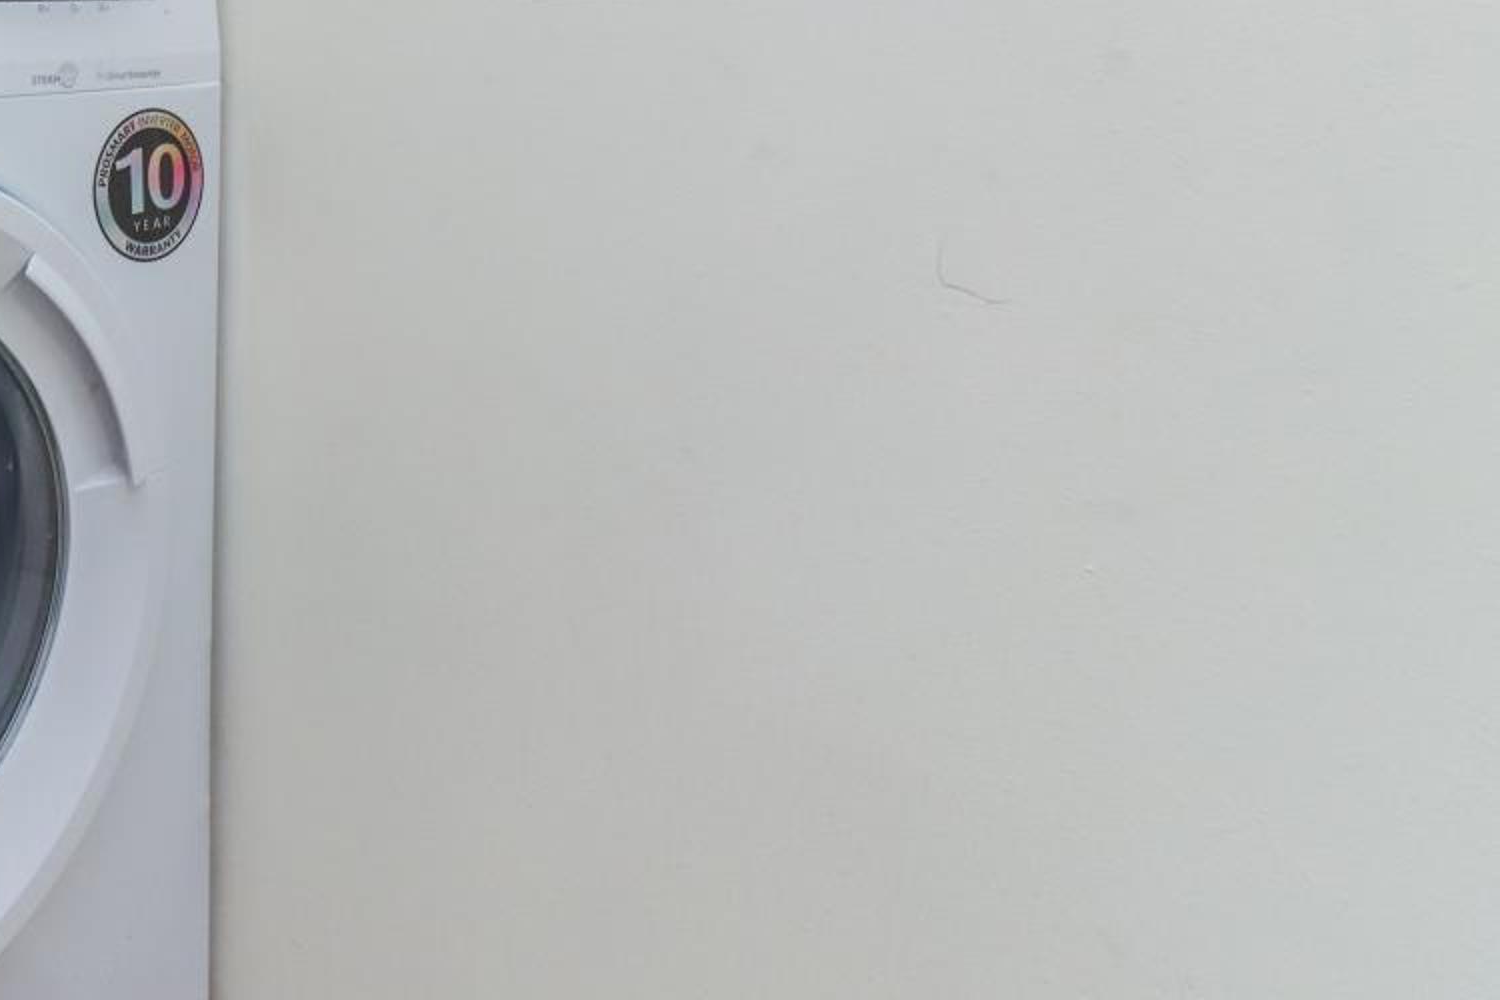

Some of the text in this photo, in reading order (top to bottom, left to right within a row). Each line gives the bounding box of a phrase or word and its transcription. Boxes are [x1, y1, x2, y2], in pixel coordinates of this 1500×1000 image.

[114, 142, 186, 216] 10
[133, 216, 171, 234] YEAR
[124, 231, 182, 257] WARRANTY
